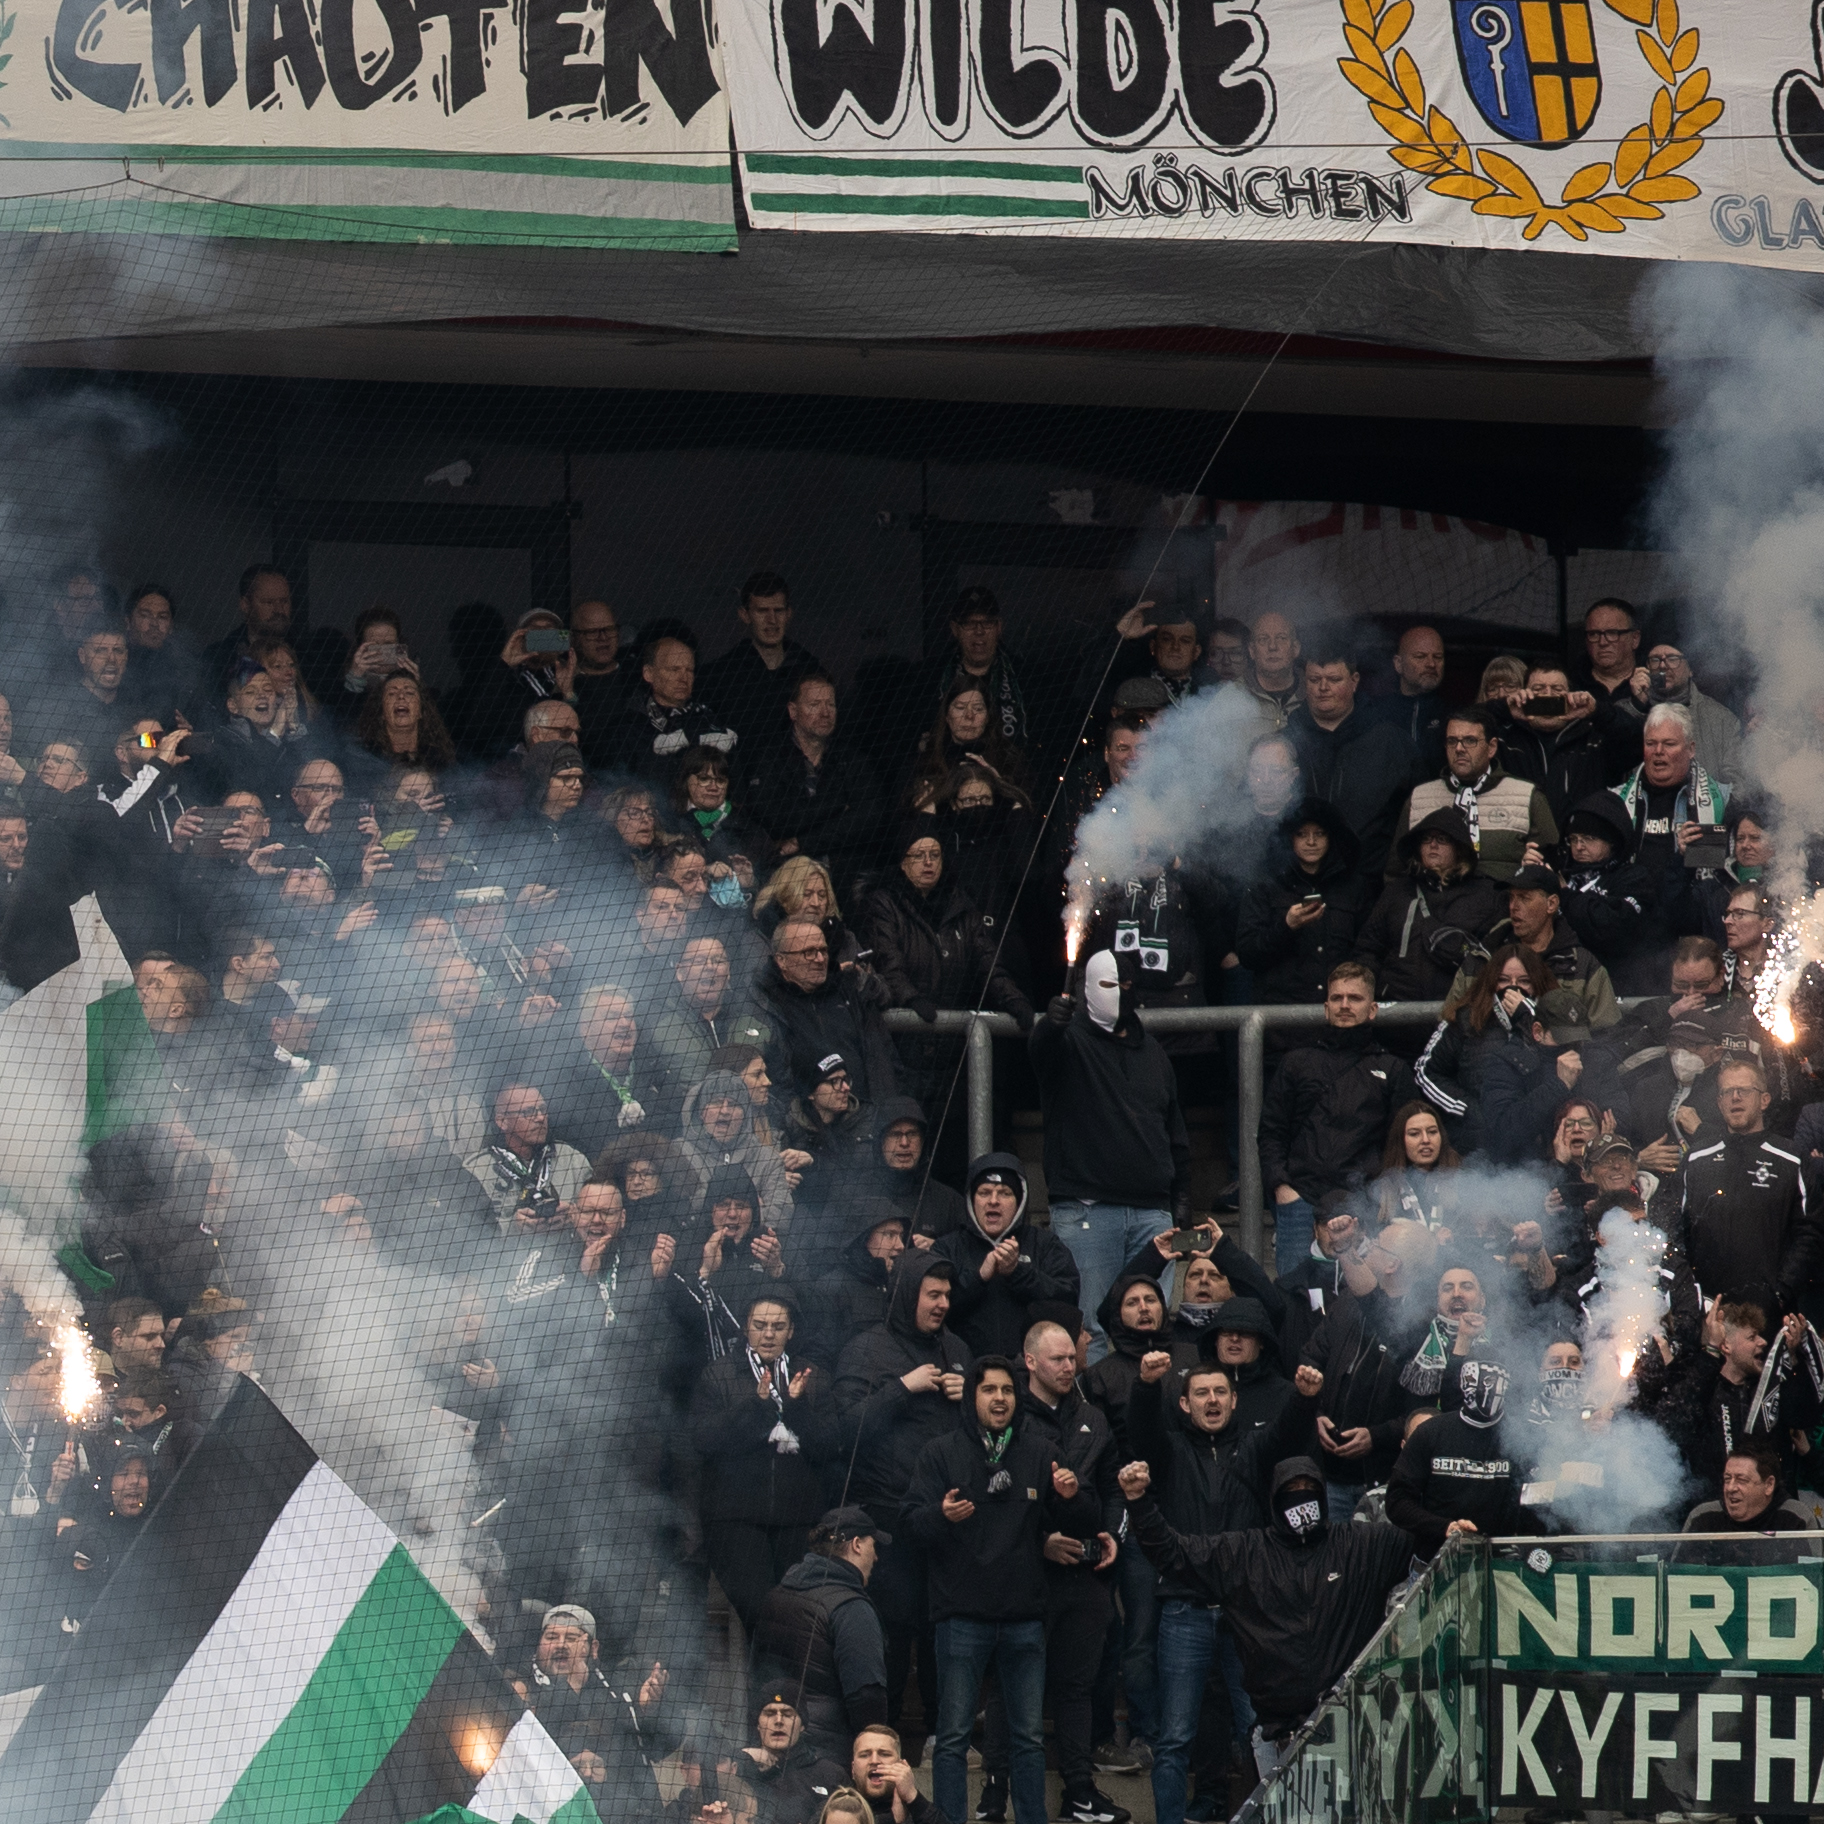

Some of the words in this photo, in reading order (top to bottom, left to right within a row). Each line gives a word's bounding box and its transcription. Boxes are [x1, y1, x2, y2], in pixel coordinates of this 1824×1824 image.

[1086, 152, 1413, 225] MÖNCHEN
[1709, 194, 1824, 251] GLA
[1492, 1568, 1821, 1662] NORD
[1499, 1683, 1824, 1806] KYFFH
